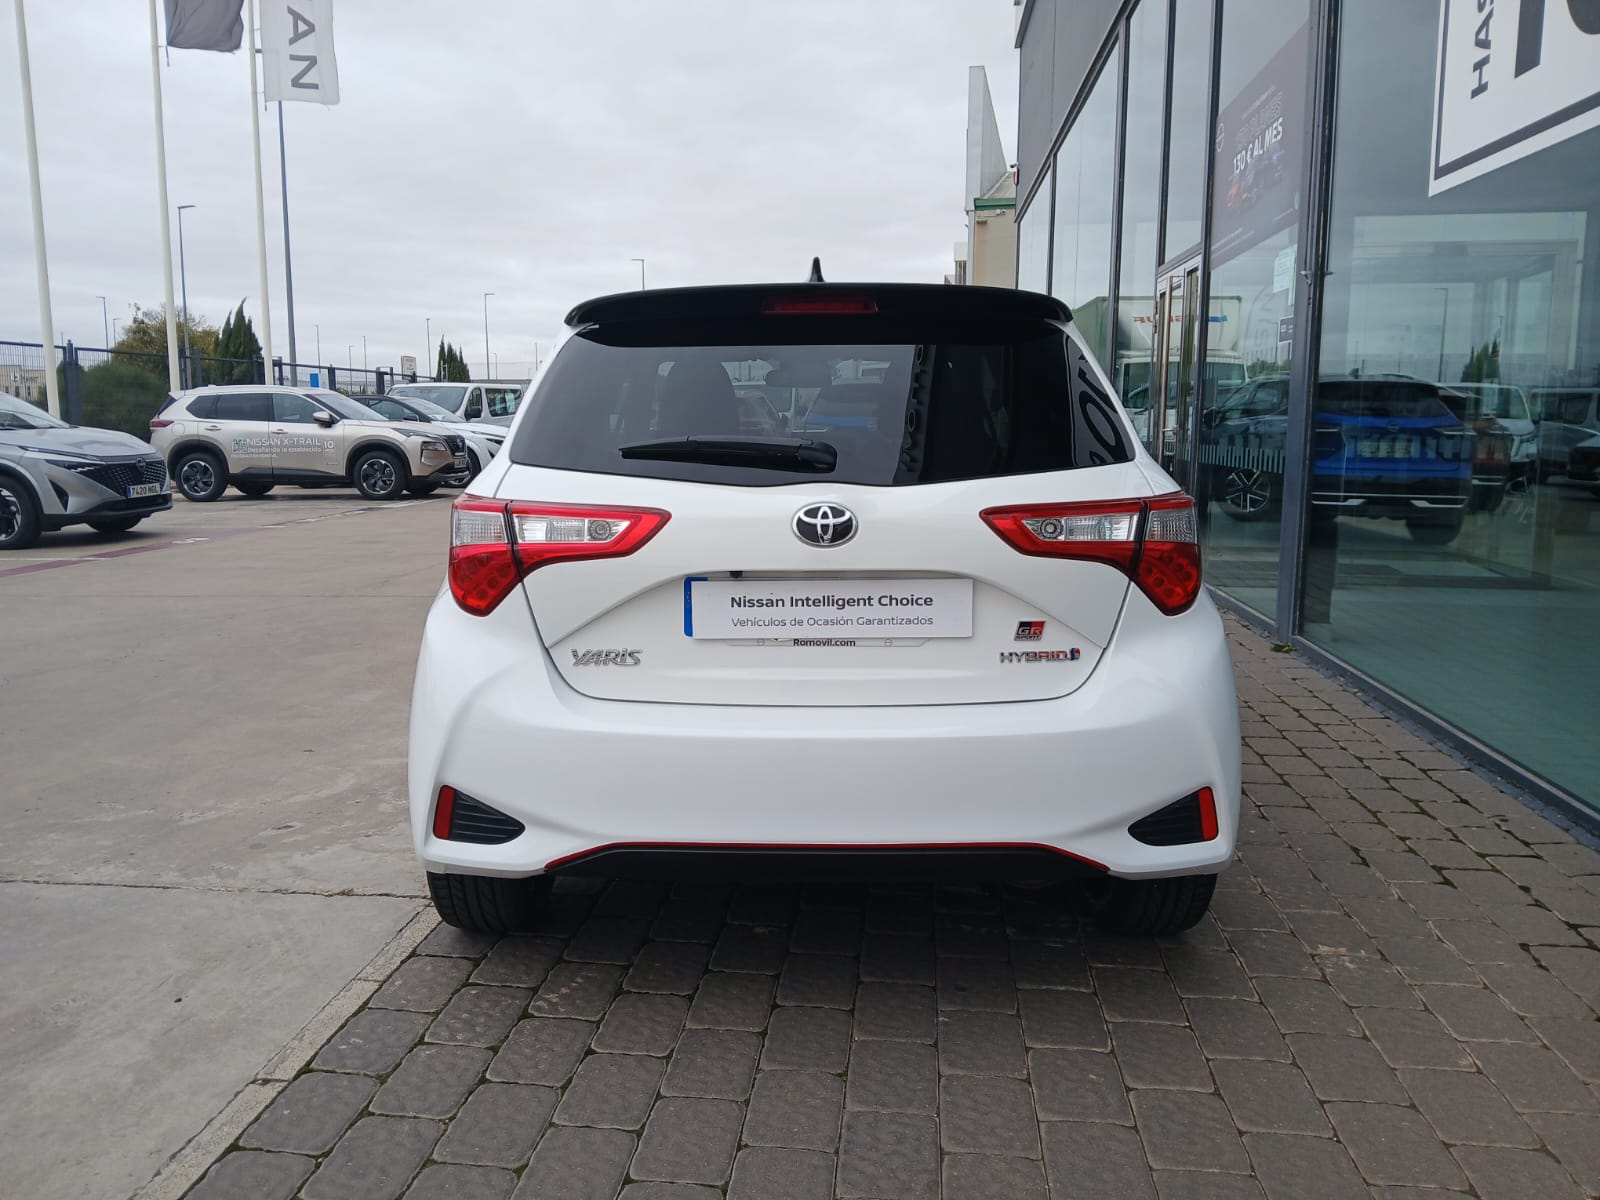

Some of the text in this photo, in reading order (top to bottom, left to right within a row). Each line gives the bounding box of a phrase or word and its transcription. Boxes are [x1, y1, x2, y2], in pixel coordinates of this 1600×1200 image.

[287, 0, 319, 90] AN
[1233, 149, 1246, 176] 130
[1253, 135, 1263, 157] AL
[1264, 117, 1283, 152] MES
[247, 437, 334, 449] NISSAN X-TRAIL 10
[131, 486, 147, 496] 7420
[730, 594, 934, 610] Nissan Intelligent Choice
[731, 615, 934, 627] Vehículos de Ocasión Garantizados
[1018, 626, 1042, 636] GR
[793, 638, 856, 647] Romovil.com
[1000, 650, 1069, 663] HYBRID
